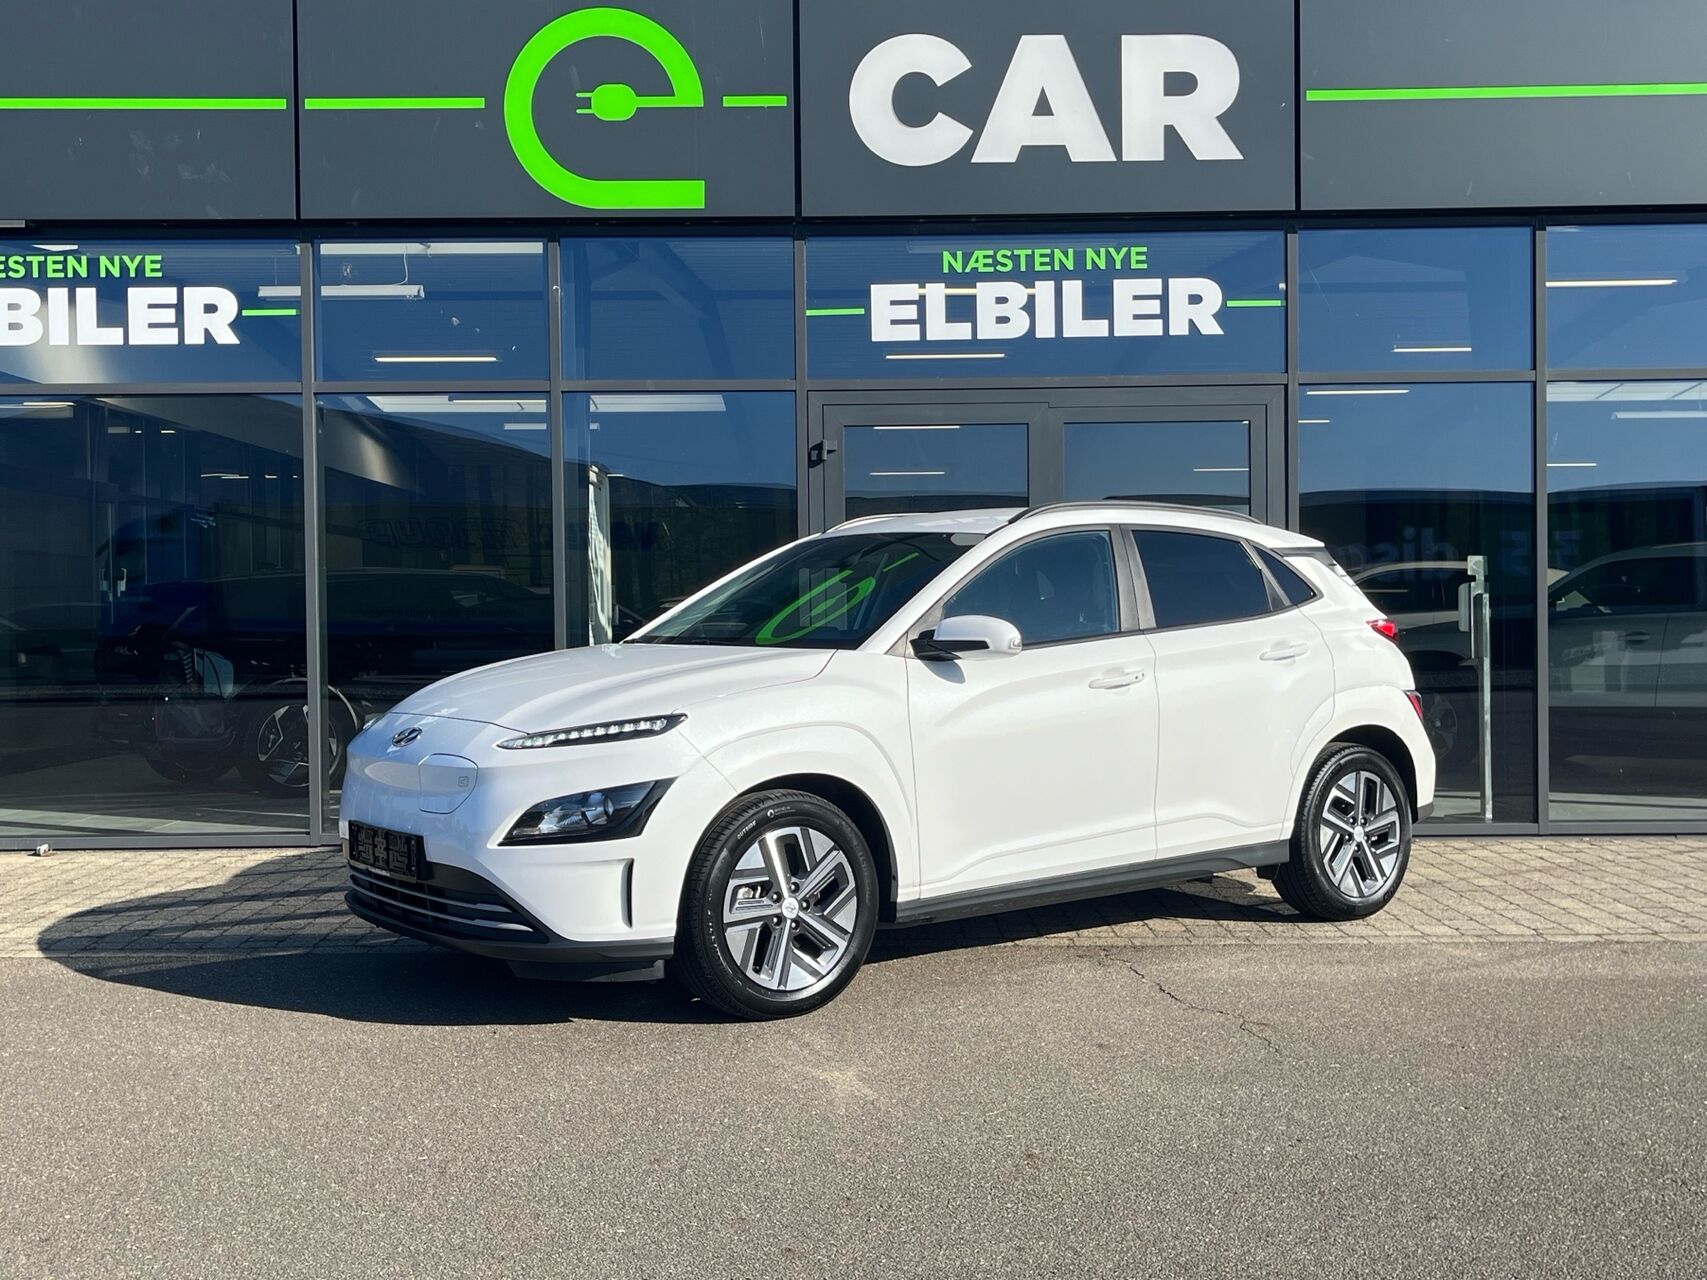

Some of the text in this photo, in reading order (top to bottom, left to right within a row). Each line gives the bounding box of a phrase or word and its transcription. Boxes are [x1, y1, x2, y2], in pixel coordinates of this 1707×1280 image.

[849, 33, 1244, 168] CAR
[0, 254, 163, 279] STEN NYE
[941, 246, 1149, 274] NÆSTEN NYE
[869, 277, 1225, 343] ELBILER
